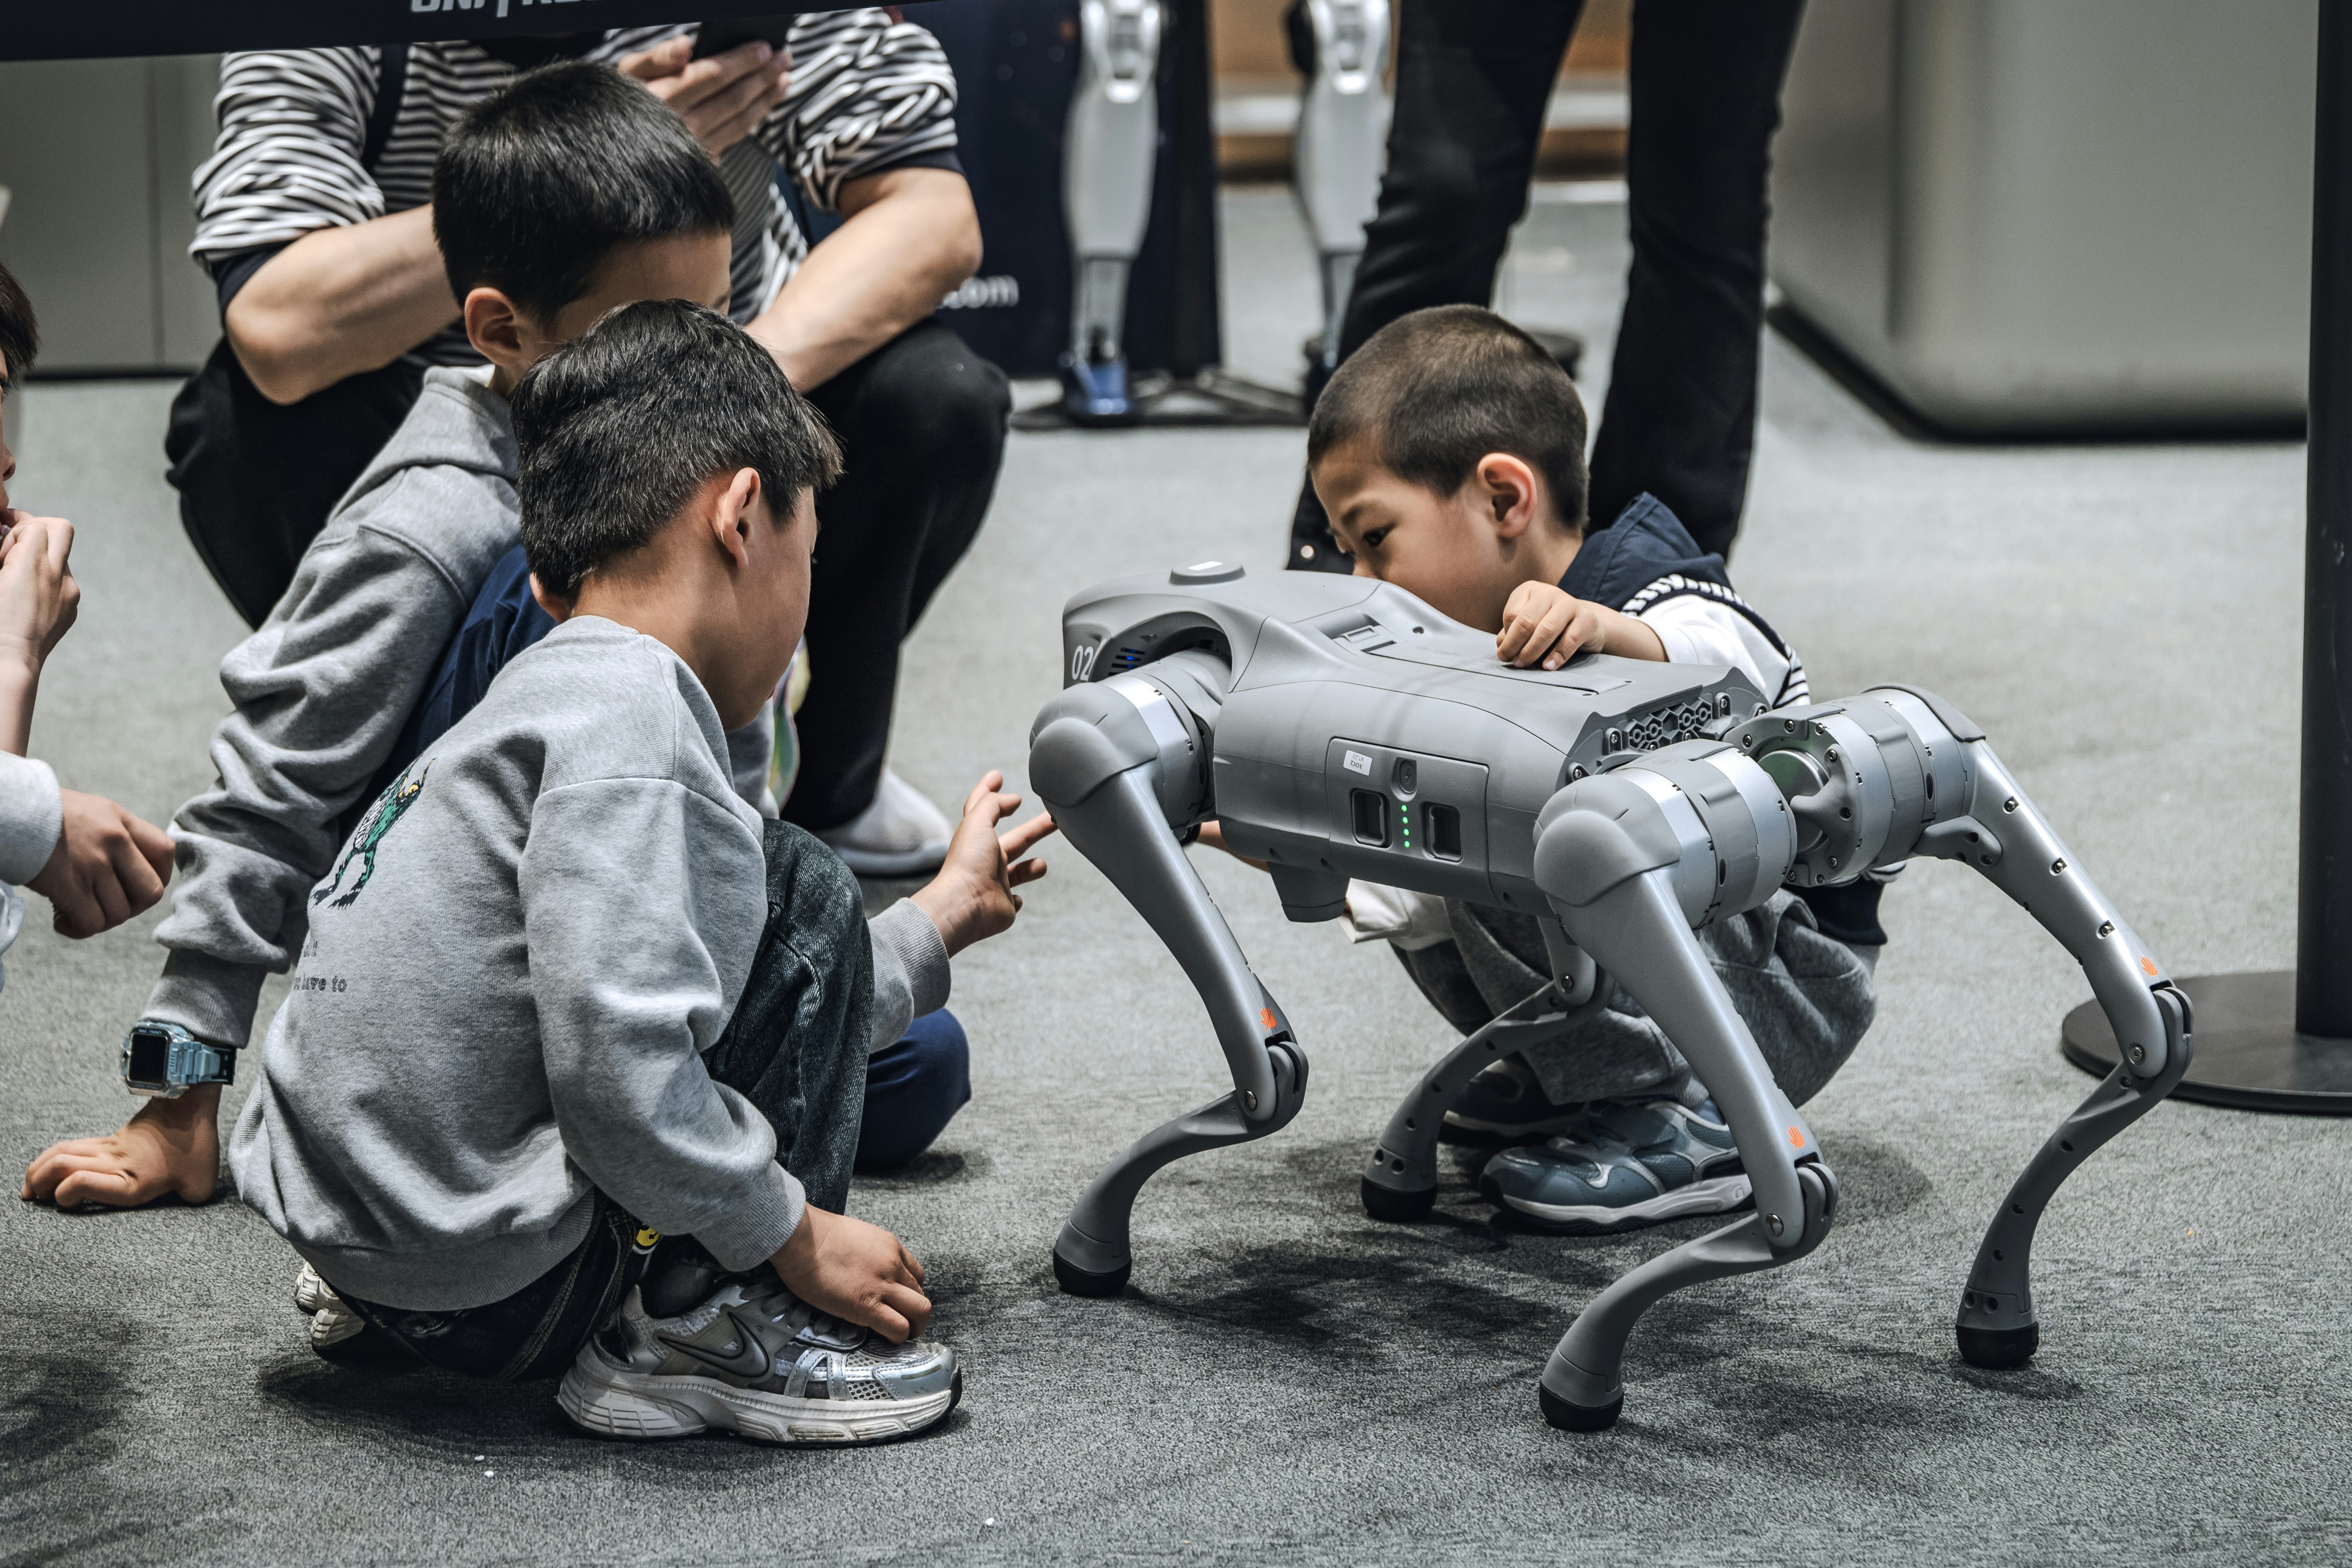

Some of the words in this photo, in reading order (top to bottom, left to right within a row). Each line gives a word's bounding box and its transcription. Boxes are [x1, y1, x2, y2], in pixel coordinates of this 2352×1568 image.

[1072, 645, 1093, 681] 02
[1351, 760, 1363, 769] 30Q
[332, 975, 347, 993] to
